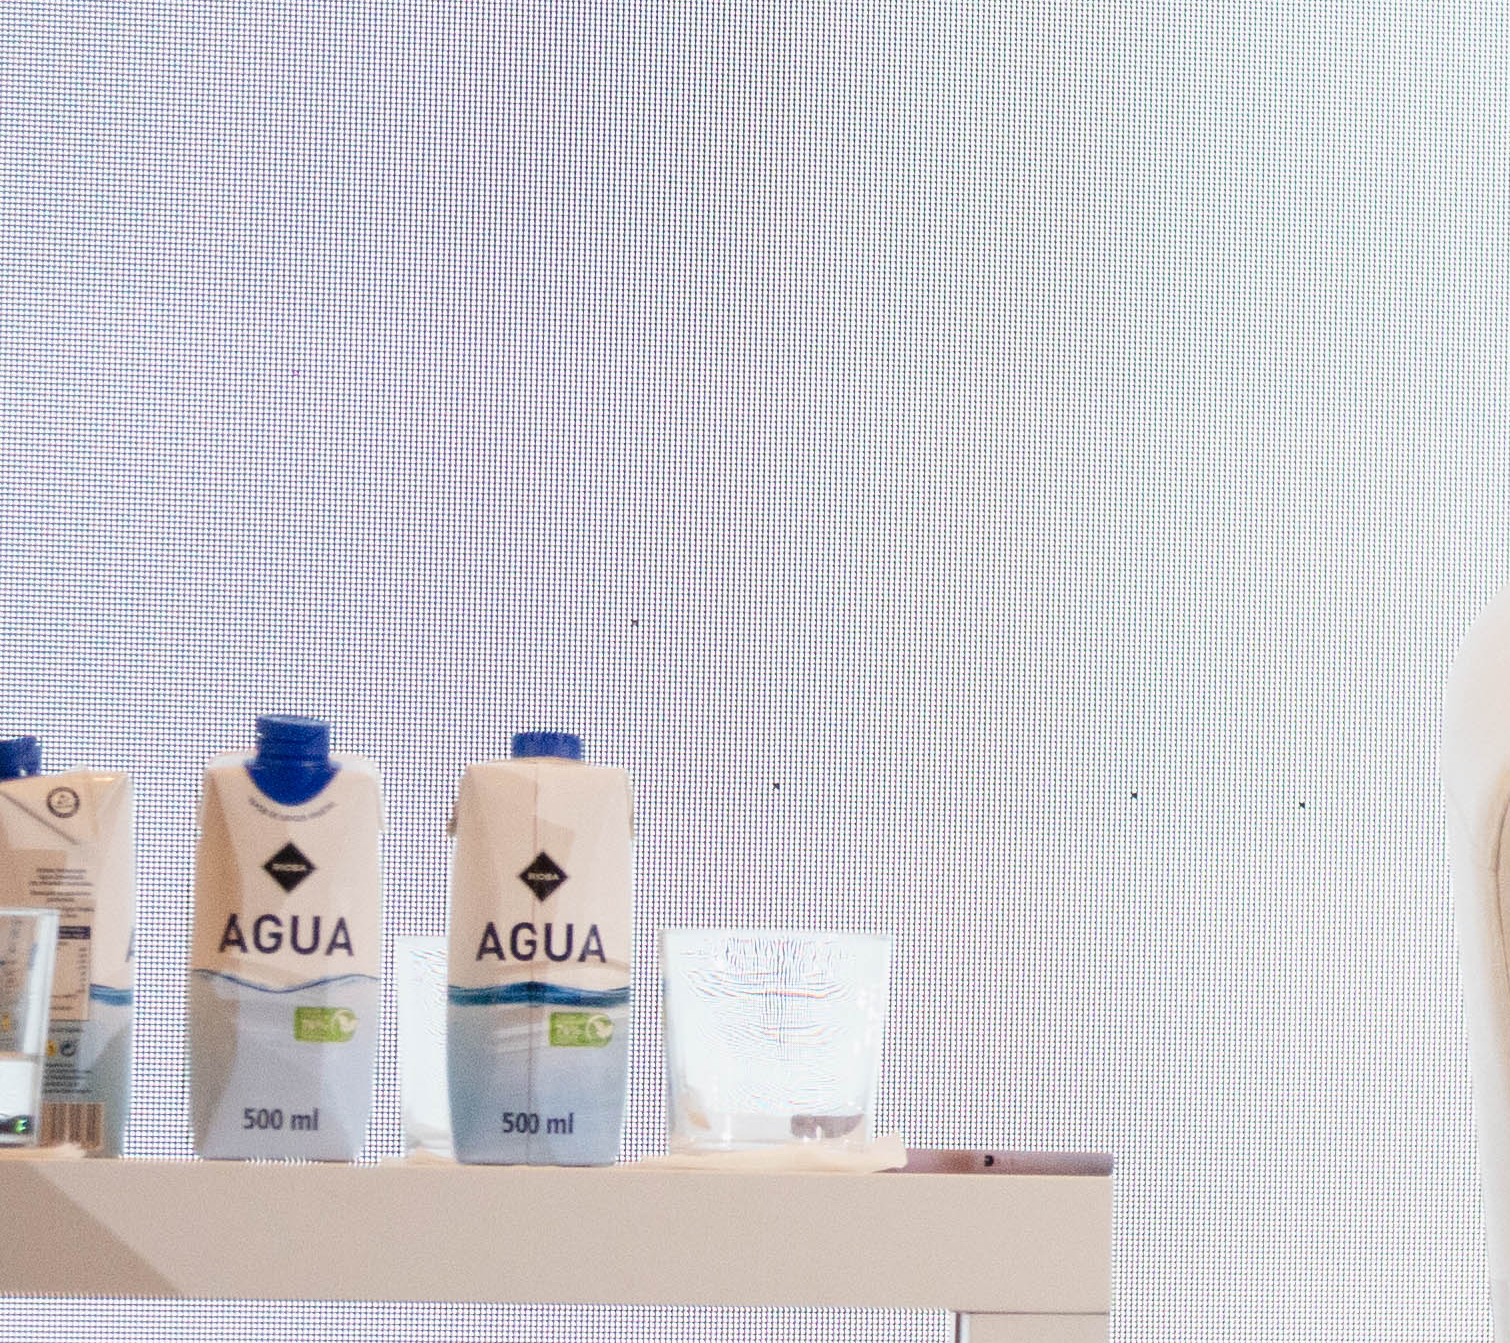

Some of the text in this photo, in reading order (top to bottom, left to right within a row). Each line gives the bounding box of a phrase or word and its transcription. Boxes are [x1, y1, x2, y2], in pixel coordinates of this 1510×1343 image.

[218, 913, 354, 957] AGUA
[476, 921, 607, 963] AGUA
[243, 1107, 319, 1131] 500 ml
[502, 1111, 574, 1135] 500 ml
